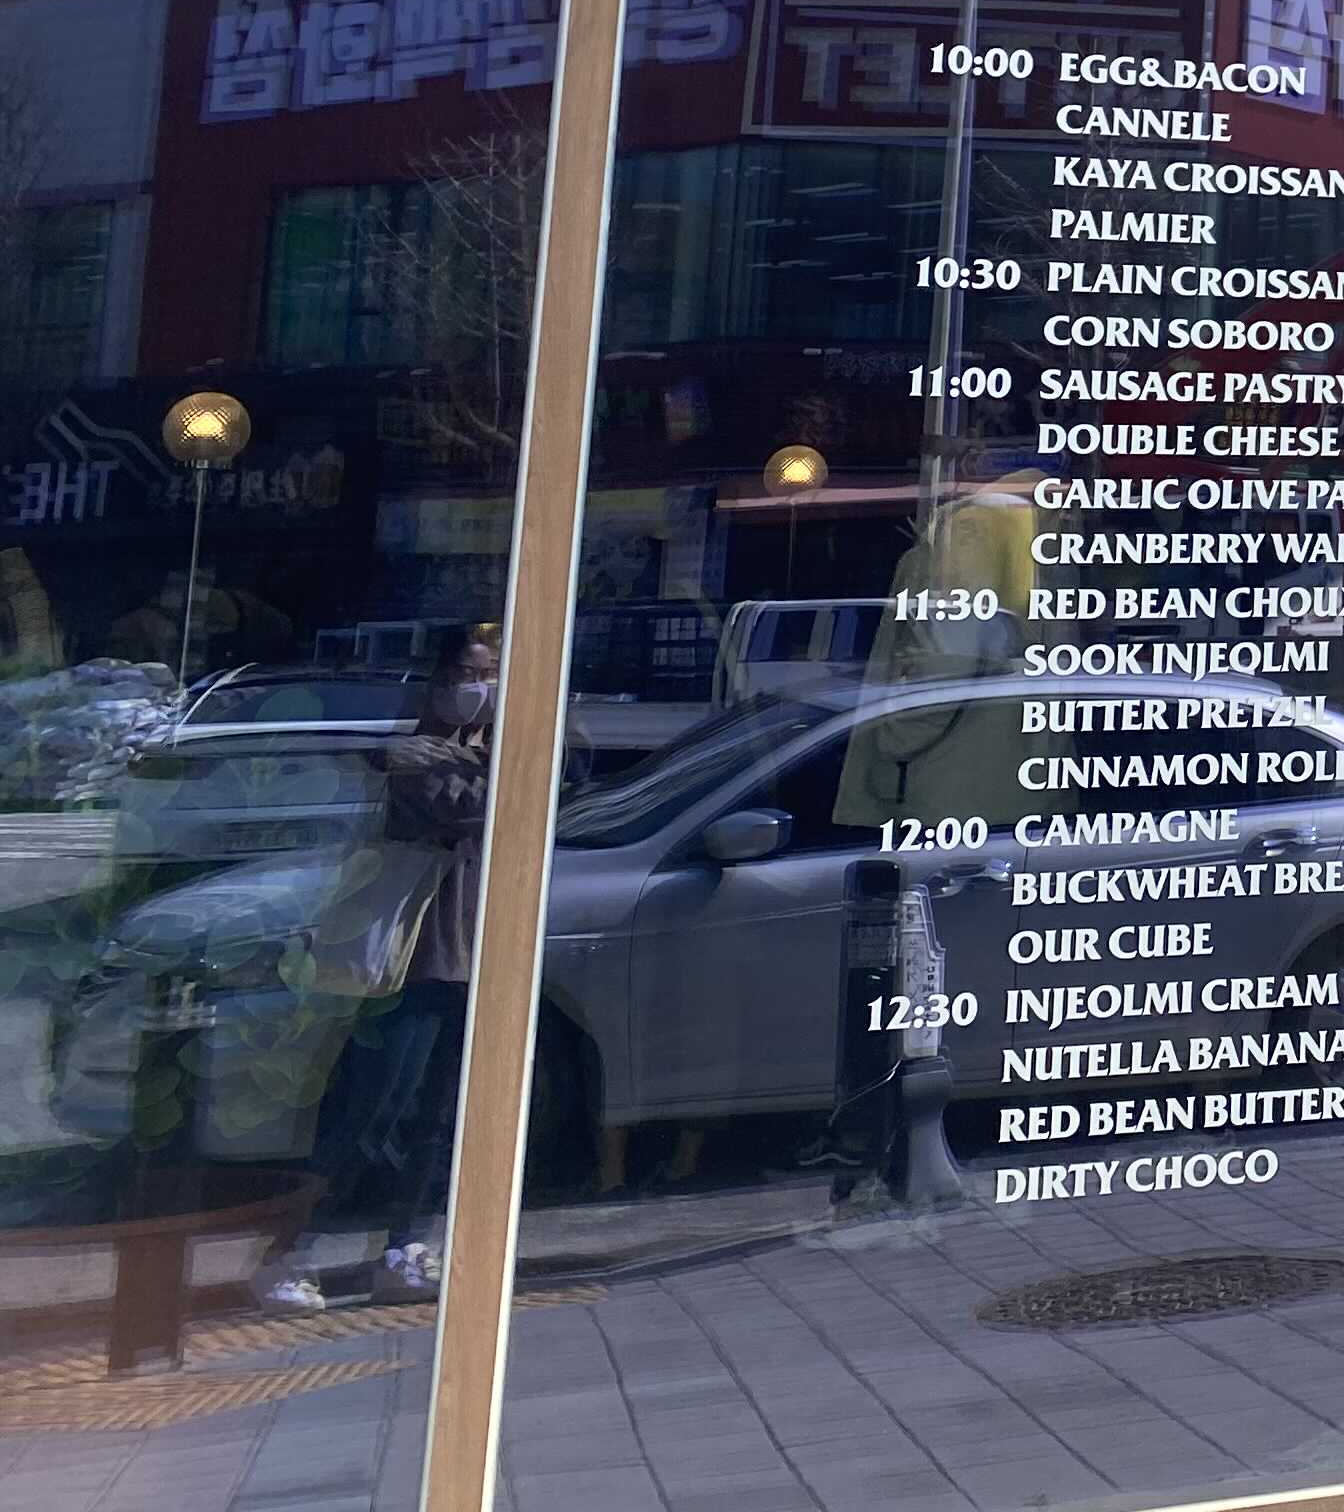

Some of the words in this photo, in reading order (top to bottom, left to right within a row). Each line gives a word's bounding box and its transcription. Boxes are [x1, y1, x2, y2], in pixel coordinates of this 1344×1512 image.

[931, 43, 1033, 78] 10:00
[1060, 53, 1306, 94] EGG&BACON
[1057, 105, 1231, 141] CANNELE
[1054, 157, 1156, 189] KAYA
[1051, 209, 1216, 243] PALMIER
[917, 257, 1020, 290] 10:30
[1048, 262, 1163, 295] PLAIN
[1044, 316, 1160, 347] CORN
[1168, 319, 1334, 351] SOBORO
[910, 365, 1011, 398] 11:00
[1040, 369, 1216, 401] SAUSAGE
[1038, 424, 1196, 454] DOUBLE
[1204, 426, 1340, 456] CHEESE
[1034, 479, 1180, 509] GARLIC
[1188, 480, 1299, 509] OLIVE
[1031, 533, 1265, 564] CRANBERRY
[895, 589, 998, 620] 11:30
[1028, 589, 1106, 619] RED
[1115, 588, 1216, 618] BEAN
[1024, 644, 1143, 676] SOOK
[1152, 642, 1329, 681] INJEOLMI
[1022, 700, 1169, 732] BUTTER
[1178, 696, 1334, 729] PRETZEL
[1018, 753, 1248, 789] CINNAMON
[880, 817, 987, 852] 12:00
[1015, 809, 1240, 847] CAMPAGNE
[1012, 864, 1267, 905] BUCKWHEAT
[1009, 929, 1101, 963] OUR
[1109, 923, 1213, 958] CUBE
[868, 993, 977, 1030] 12:30
[1006, 981, 1192, 1030] INJEOLMI
[1202, 974, 1338, 1011] CREAM
[1002, 1040, 1181, 1082] NUTELLA
[999, 1106, 1080, 1142] RED
[1089, 1097, 1195, 1136] BEAN
[996, 1161, 1119, 1203] DIRTY
[1126, 1150, 1278, 1191] CHOCO
